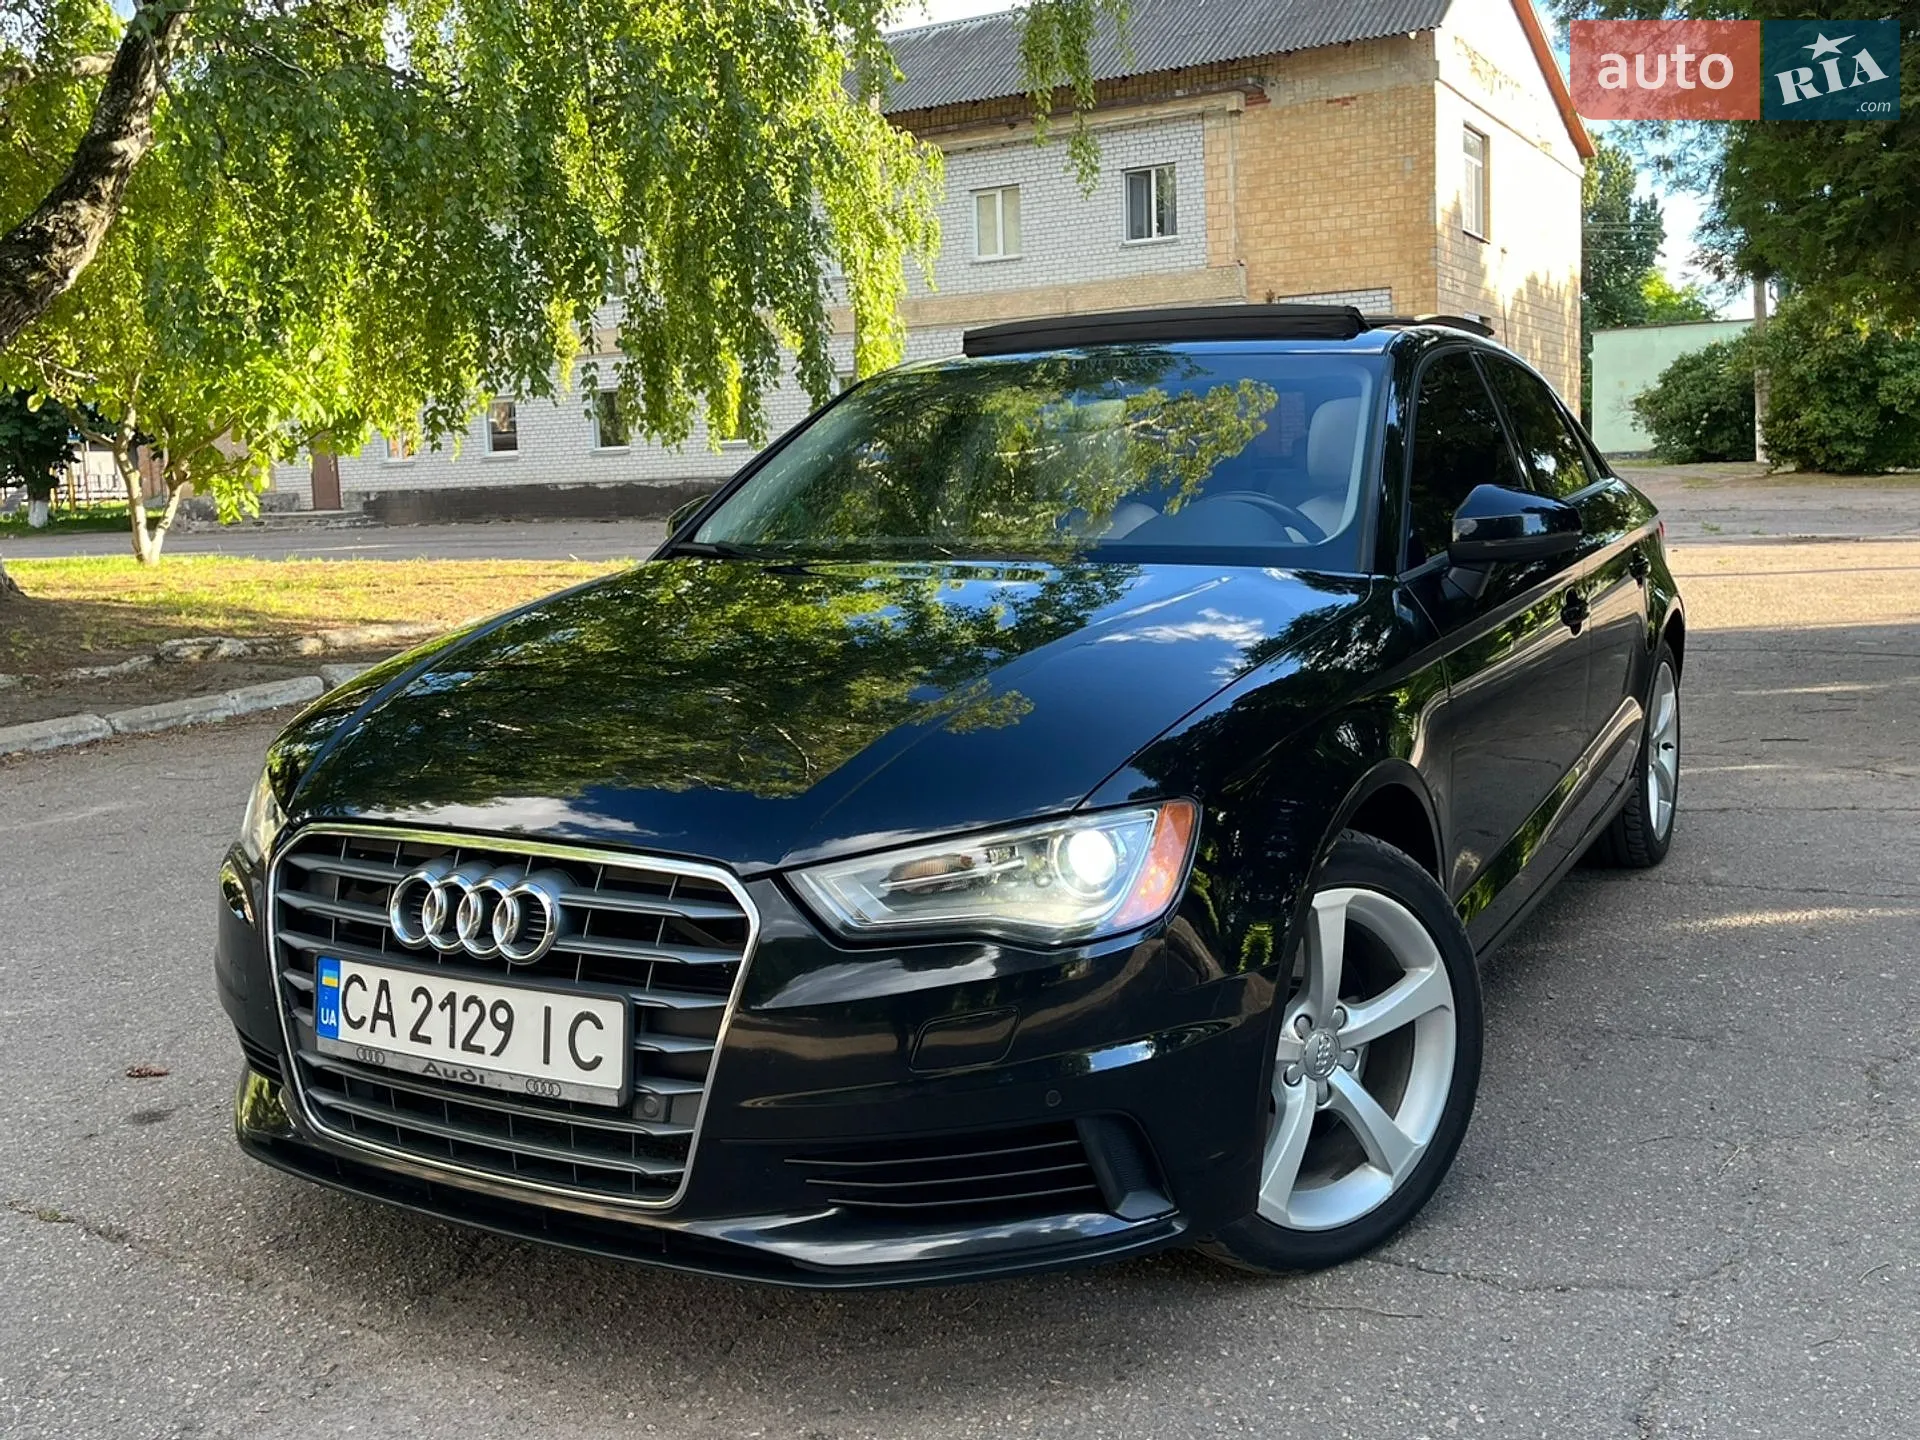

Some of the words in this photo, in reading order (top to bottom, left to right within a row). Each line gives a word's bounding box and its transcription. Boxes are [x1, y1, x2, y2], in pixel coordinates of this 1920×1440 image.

[321, 1008, 337, 1027] UA
[341, 973, 397, 1038] CA
[409, 986, 515, 1057] 2129
[542, 1005, 604, 1072] IC
[422, 1061, 485, 1084] Audi
